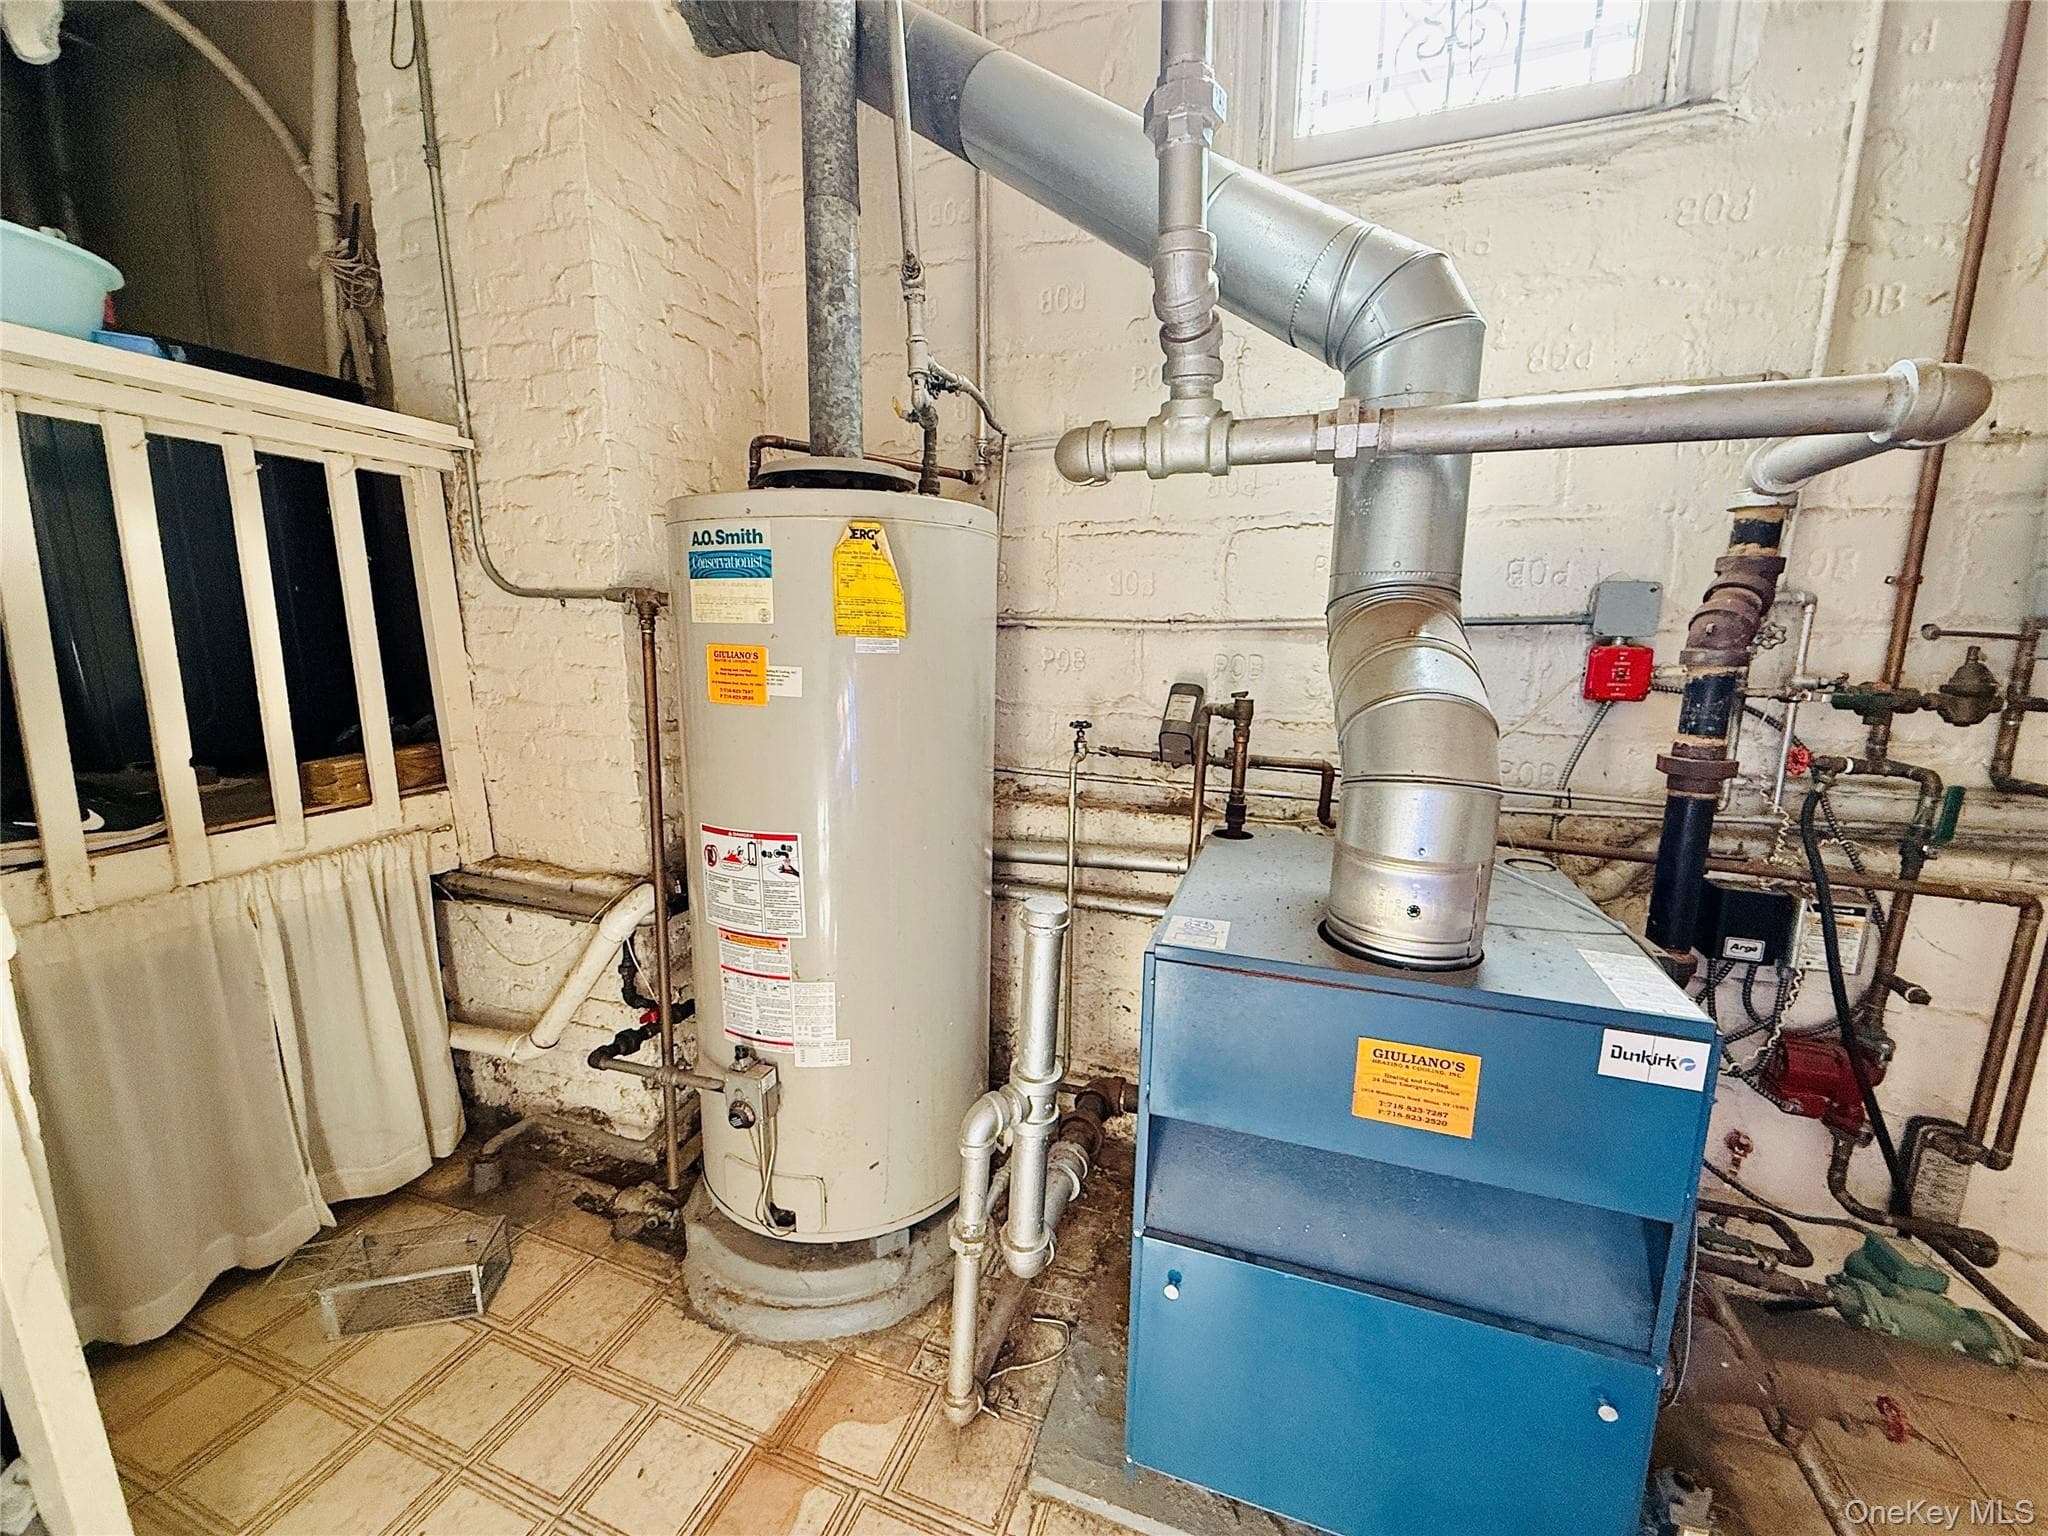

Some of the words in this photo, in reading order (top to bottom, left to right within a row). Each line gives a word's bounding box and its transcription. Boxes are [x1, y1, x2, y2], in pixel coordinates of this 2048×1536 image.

[715, 528, 764, 545] Smith
[691, 553, 764, 570] Conservationist
[713, 650, 759, 660] GIULIANO'S
[1040, 647, 1088, 674] POB
[1371, 1058, 1403, 1070] HEATING
[1372, 1048, 1466, 1073] GIULIANO'S
[1610, 1044, 1678, 1070] Dunkirk
